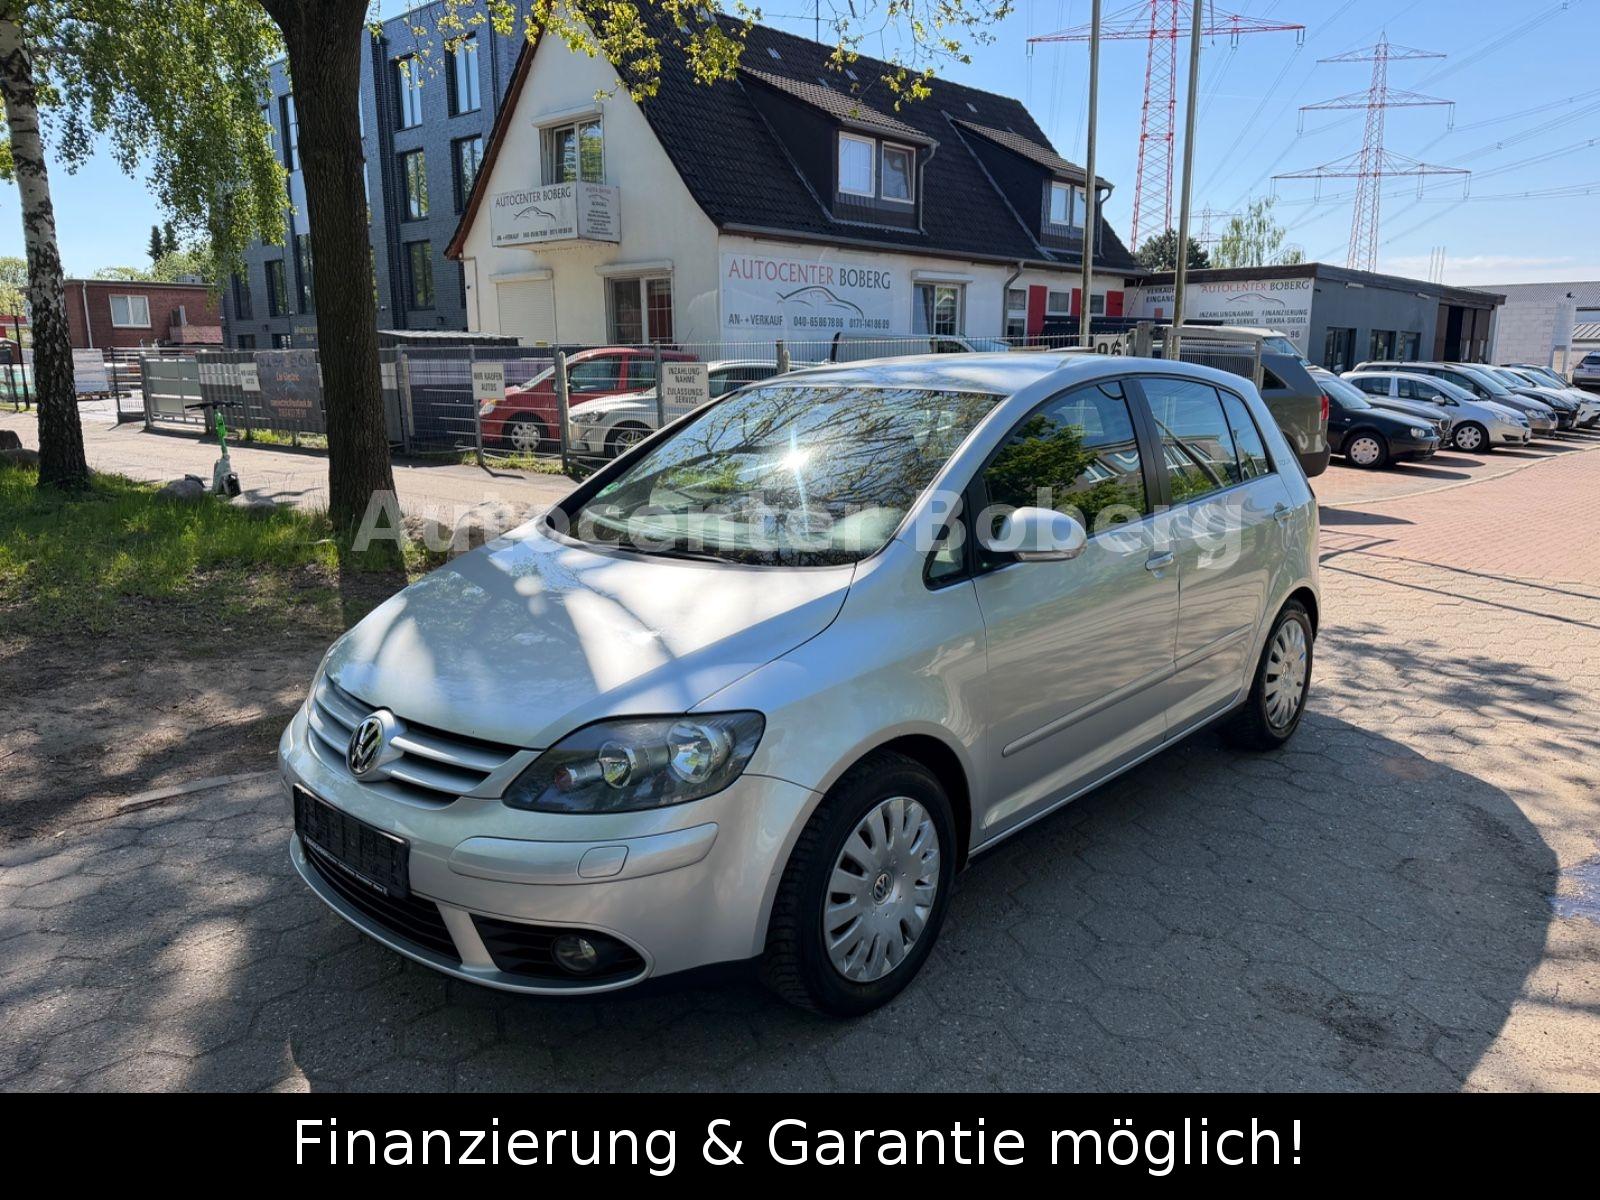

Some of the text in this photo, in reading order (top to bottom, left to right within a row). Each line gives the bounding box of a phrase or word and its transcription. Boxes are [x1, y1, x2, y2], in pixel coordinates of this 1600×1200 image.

[495, 191, 542, 207] AUTOCENTER
[543, 186, 571, 201] BOBERG
[728, 258, 891, 290] AUTOCENTER BOBERG
[1201, 280, 1310, 294] AUTOCENTER BOBERG
[750, 314, 783, 326] VERKAUF
[675, 375, 696, 384] NAHME
[481, 383, 497, 392] AUTOS
[675, 396, 698, 404] SERVICE
